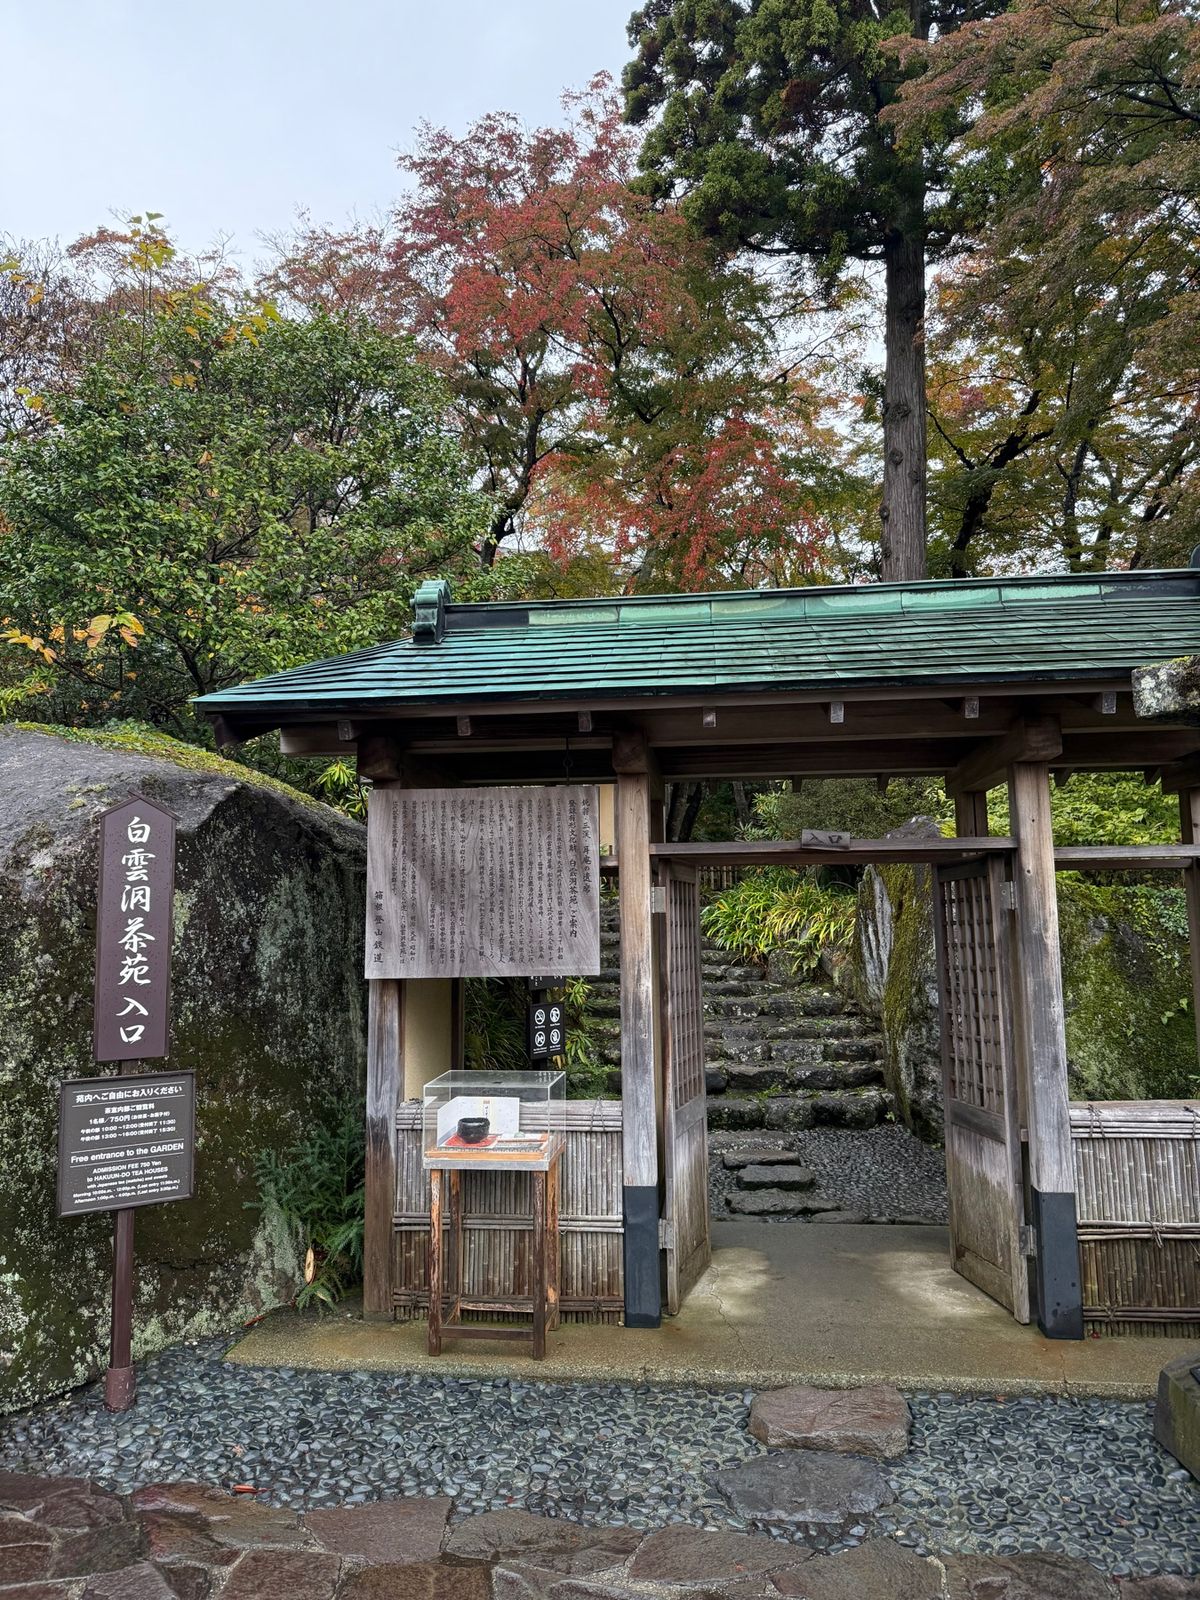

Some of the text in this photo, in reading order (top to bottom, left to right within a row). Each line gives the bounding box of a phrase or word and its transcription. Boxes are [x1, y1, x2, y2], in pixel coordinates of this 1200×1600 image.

[809, 832, 843, 844] 入口
[115, 816, 155, 1044] 白雲洞茶苑 入口
[373, 890, 384, 963] 箱根登山鉄道
[76, 1086, 182, 1103] 苑内へご自由にお入りください
[91, 1151, 125, 1161] entrance
[150, 1143, 184, 1153] GARDEN
[93, 1165, 126, 1174] ADMISSION
[94, 1172, 131, 1181] HAKUUN-DO
